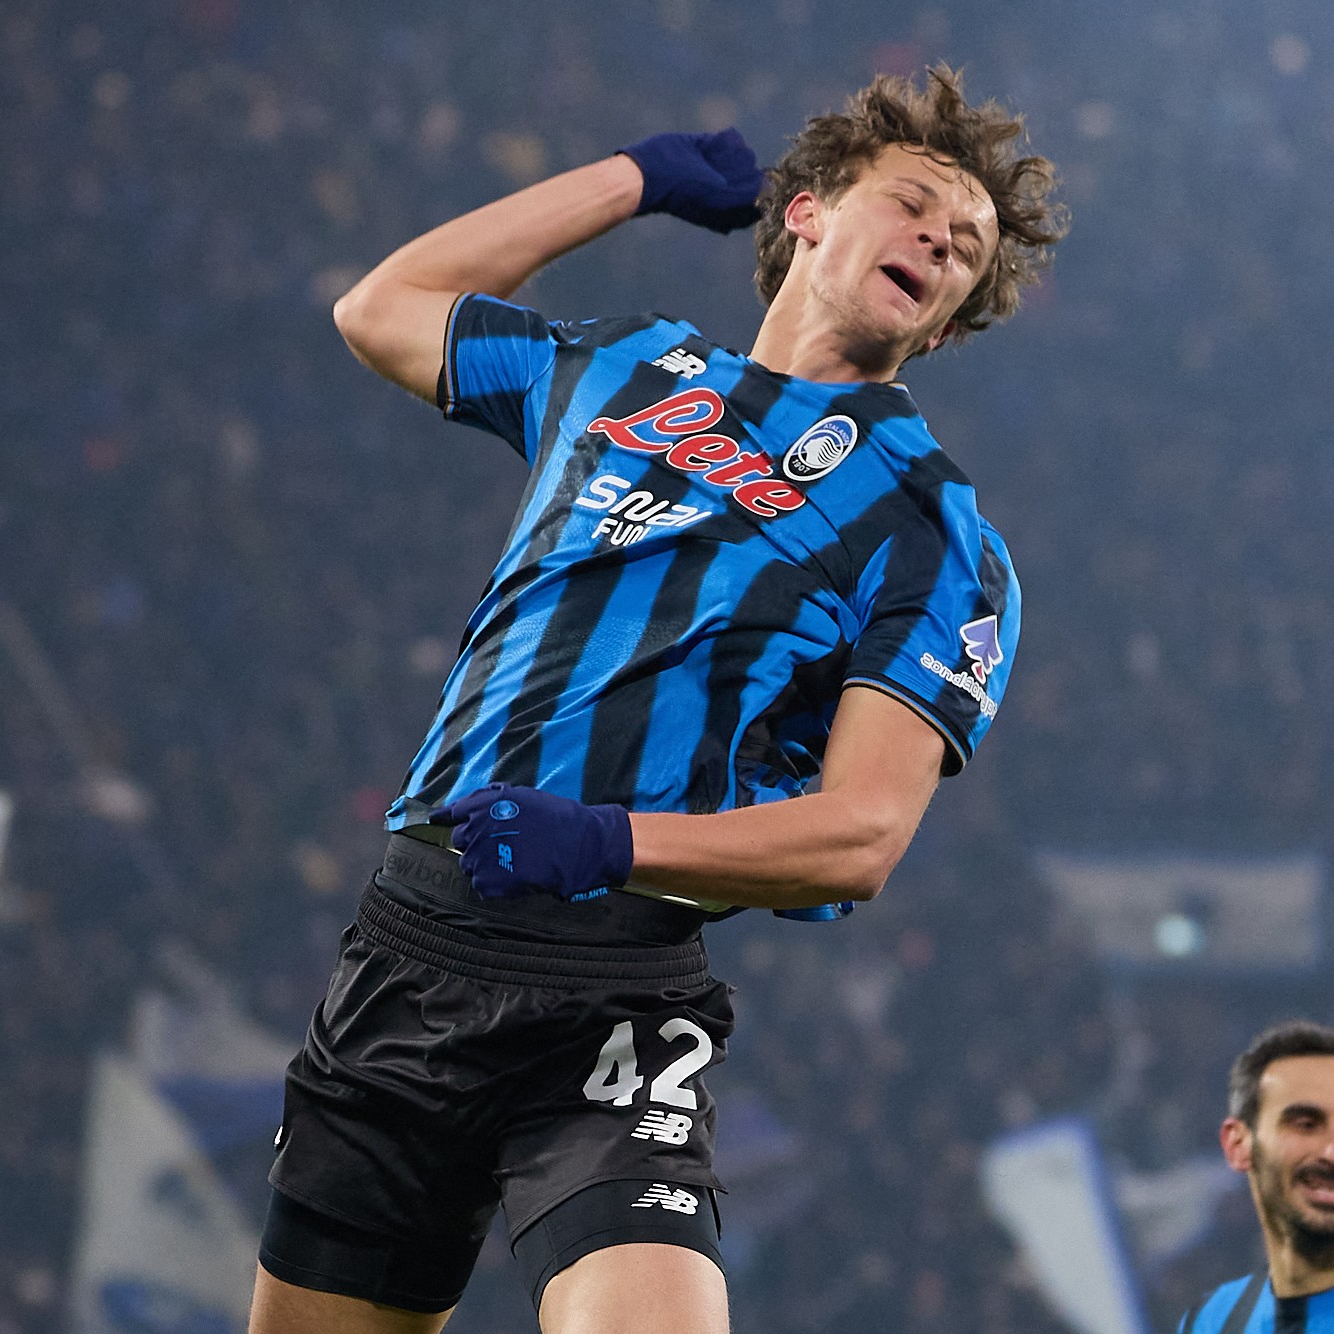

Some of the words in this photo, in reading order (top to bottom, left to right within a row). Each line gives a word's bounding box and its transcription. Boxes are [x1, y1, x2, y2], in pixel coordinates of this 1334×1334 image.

[586, 387, 806, 517] Lete
[792, 458, 811, 474] 1907
[583, 1018, 713, 1110] 42
[630, 1110, 693, 1146] NB
[631, 1183, 699, 1216] NB
